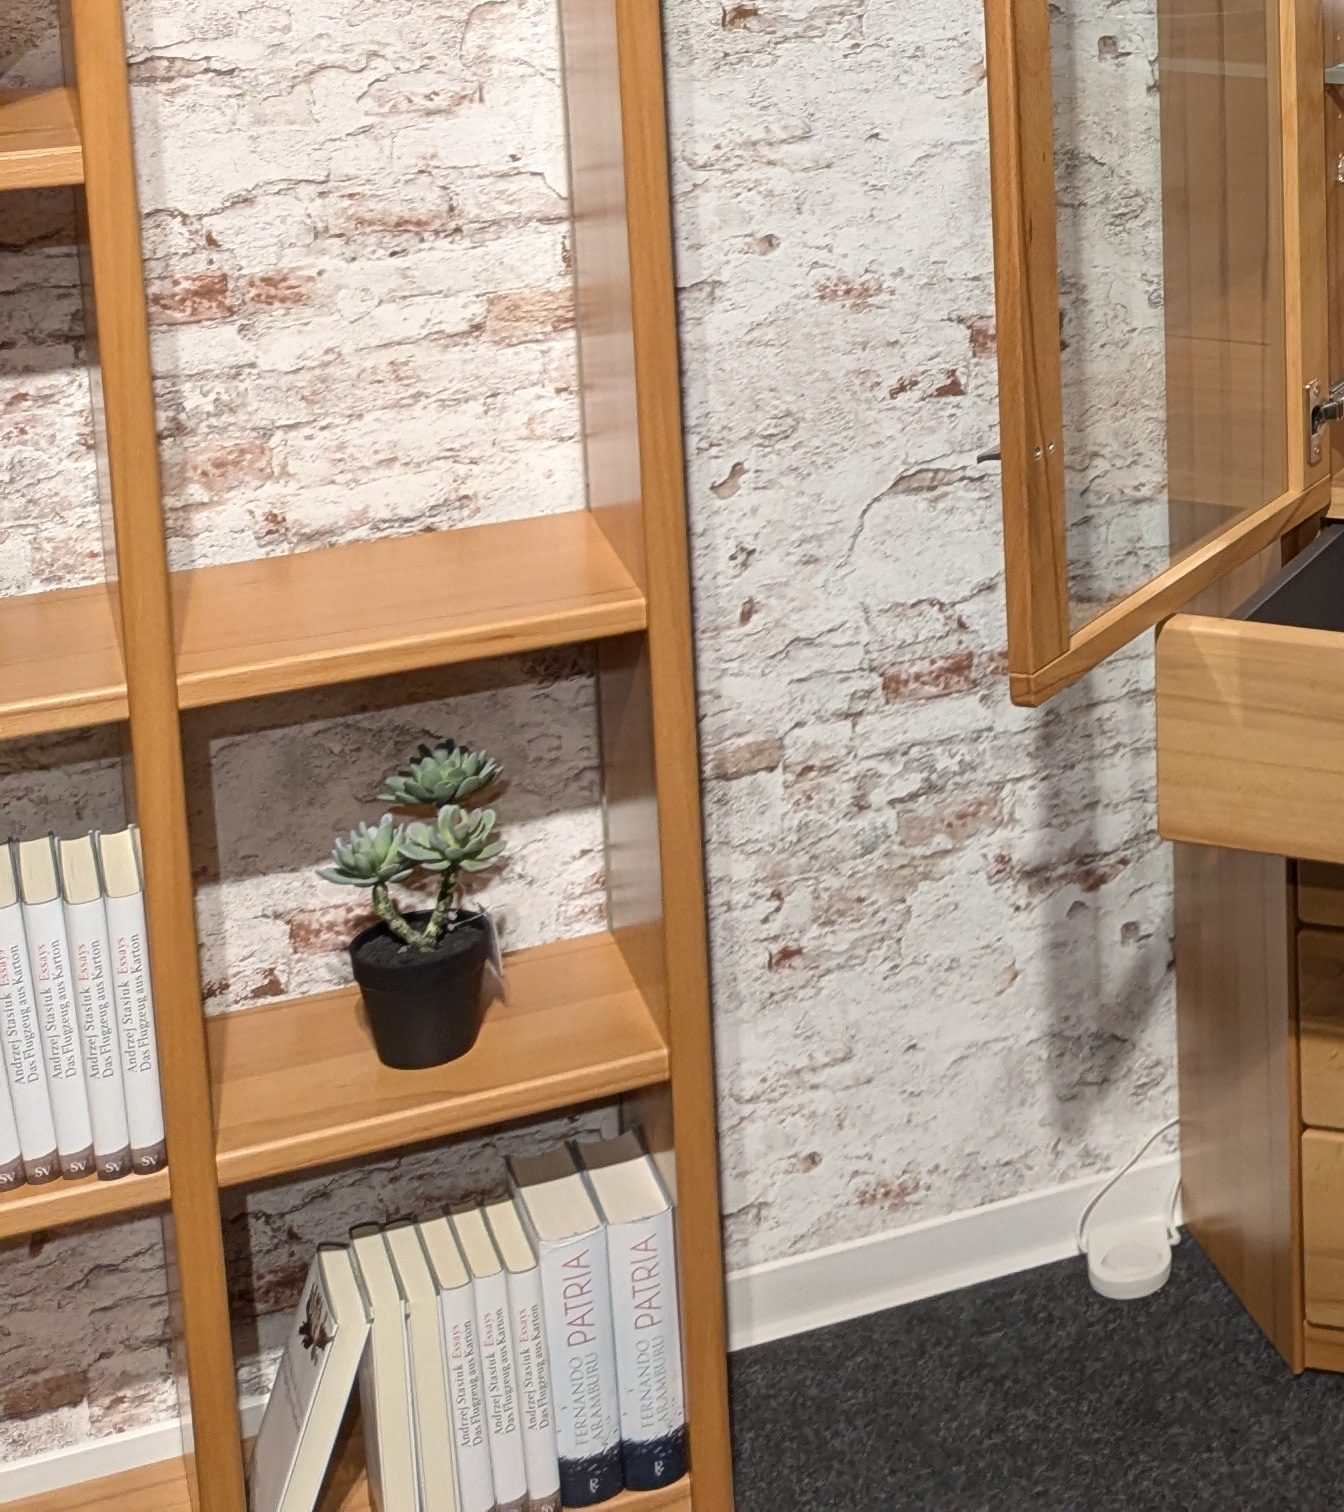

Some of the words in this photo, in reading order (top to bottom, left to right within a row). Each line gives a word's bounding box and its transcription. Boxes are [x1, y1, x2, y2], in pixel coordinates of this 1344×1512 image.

[57, 981, 68, 1001] aus
[96, 981, 106, 1000] aus
[134, 974, 144, 994] aus
[17, 986, 28, 1006] aus
[27, 1060, 39, 1083] Das
[65, 1056, 77, 1079] Das
[102, 1056, 115, 1078] Das
[139, 1049, 152, 1072] Das
[630, 1232, 663, 1330] PATRIA
[562, 1249, 597, 1348] PATRIA
[636, 1339, 655, 1428] FERNANDO
[651, 1336, 669, 1427] ARAMBURU
[568, 1357, 588, 1447] FERNANDO
[583, 1351, 604, 1442] ARAMBURU
